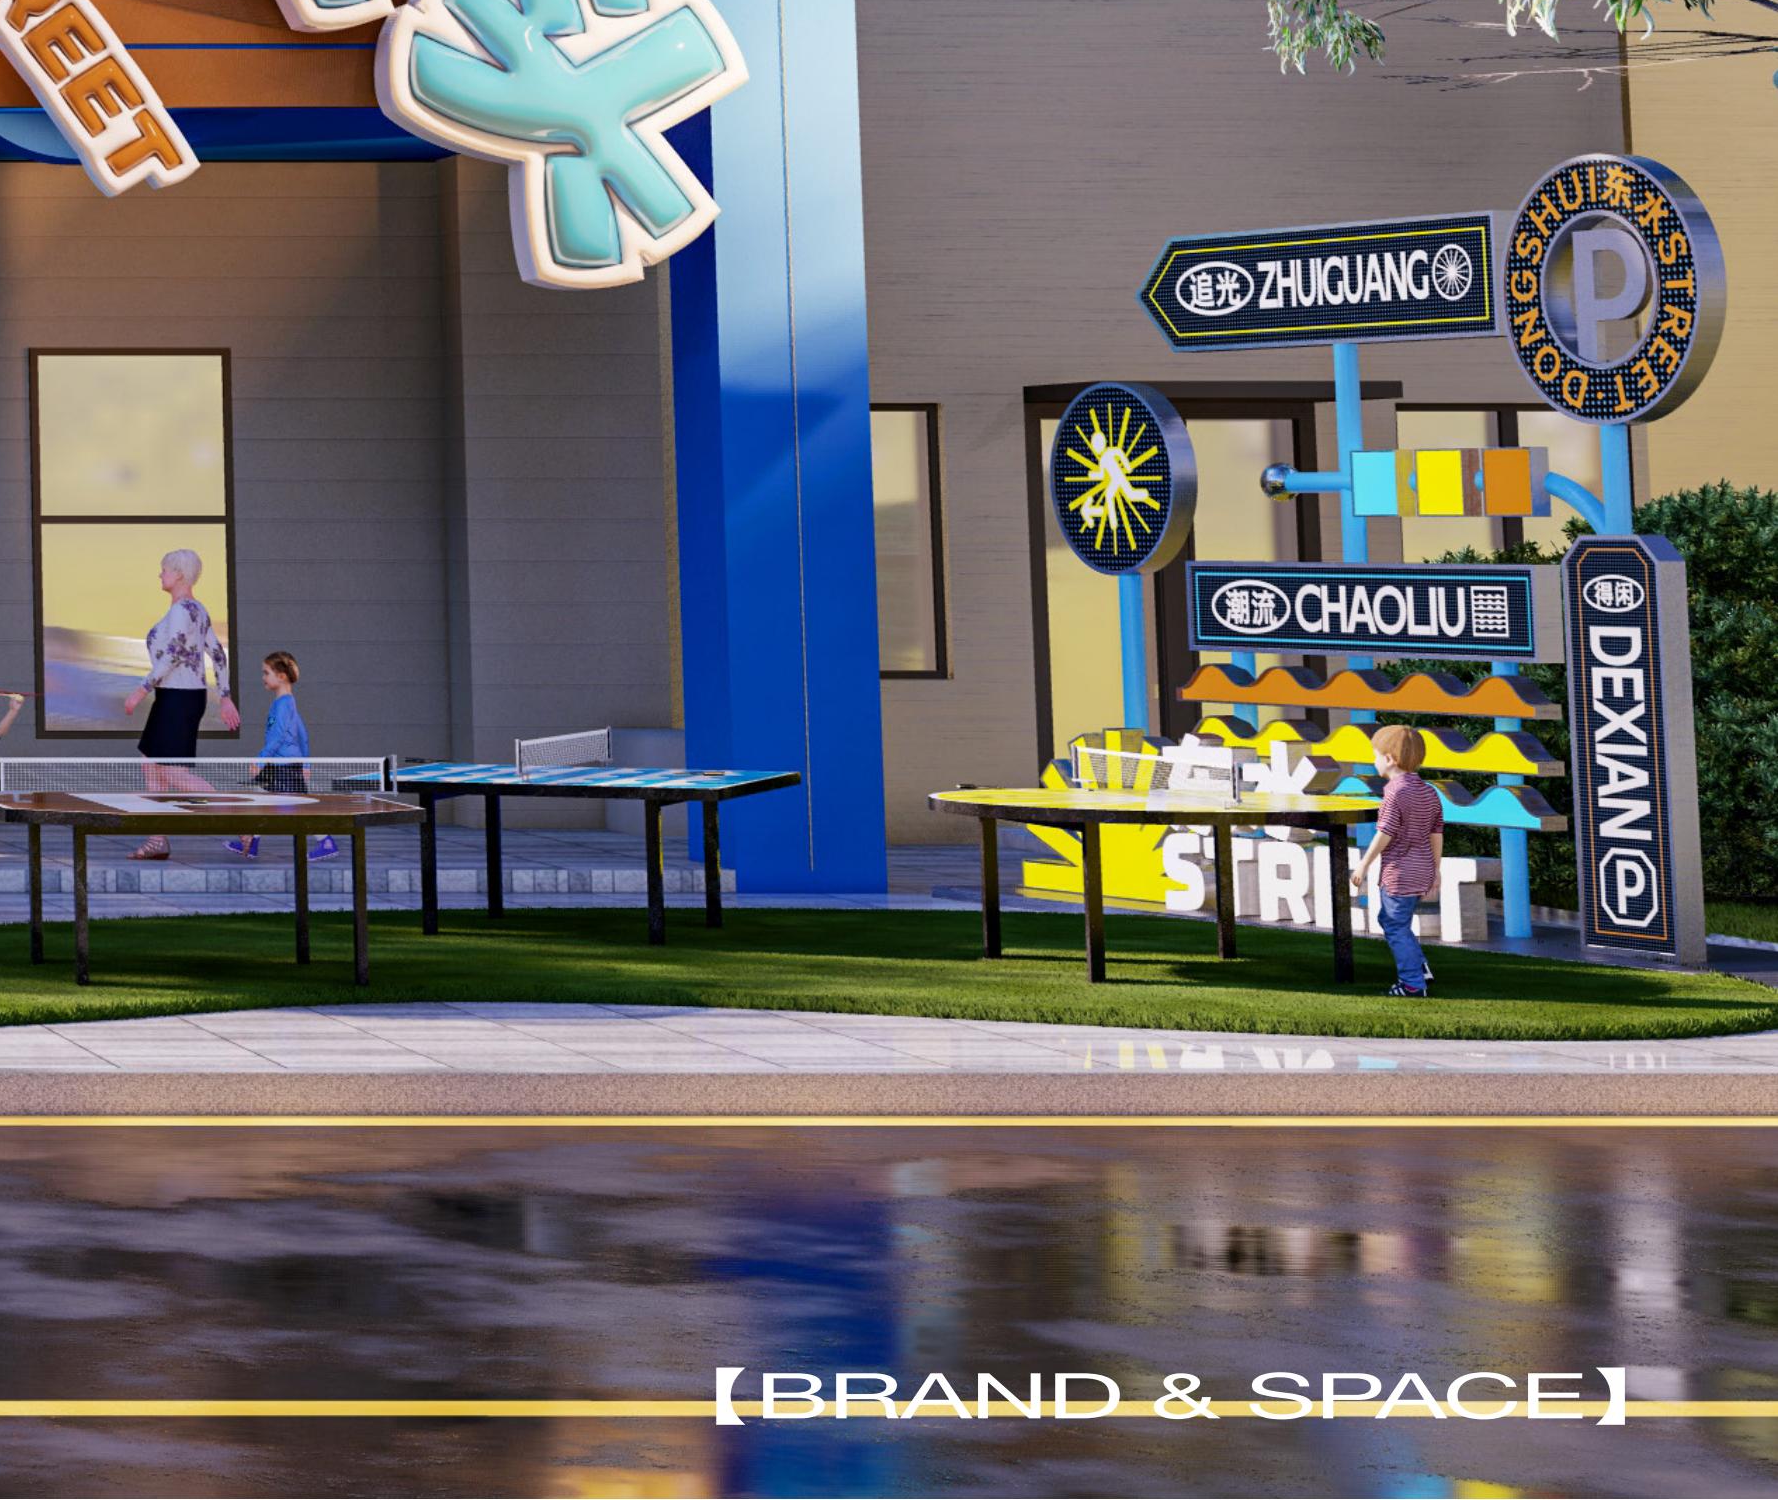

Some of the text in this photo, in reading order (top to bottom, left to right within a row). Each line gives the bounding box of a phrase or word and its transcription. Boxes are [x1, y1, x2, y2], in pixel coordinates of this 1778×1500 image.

[1189, 249, 1430, 309] 追光 ZHUIGUANG
[1571, 228, 1647, 363] P
[1225, 583, 1466, 637] 潮流 CHAOLIU
[1594, 581, 1634, 607] 得闲
[1589, 626, 1652, 841] DEXIAN
[1615, 859, 1647, 915] P
